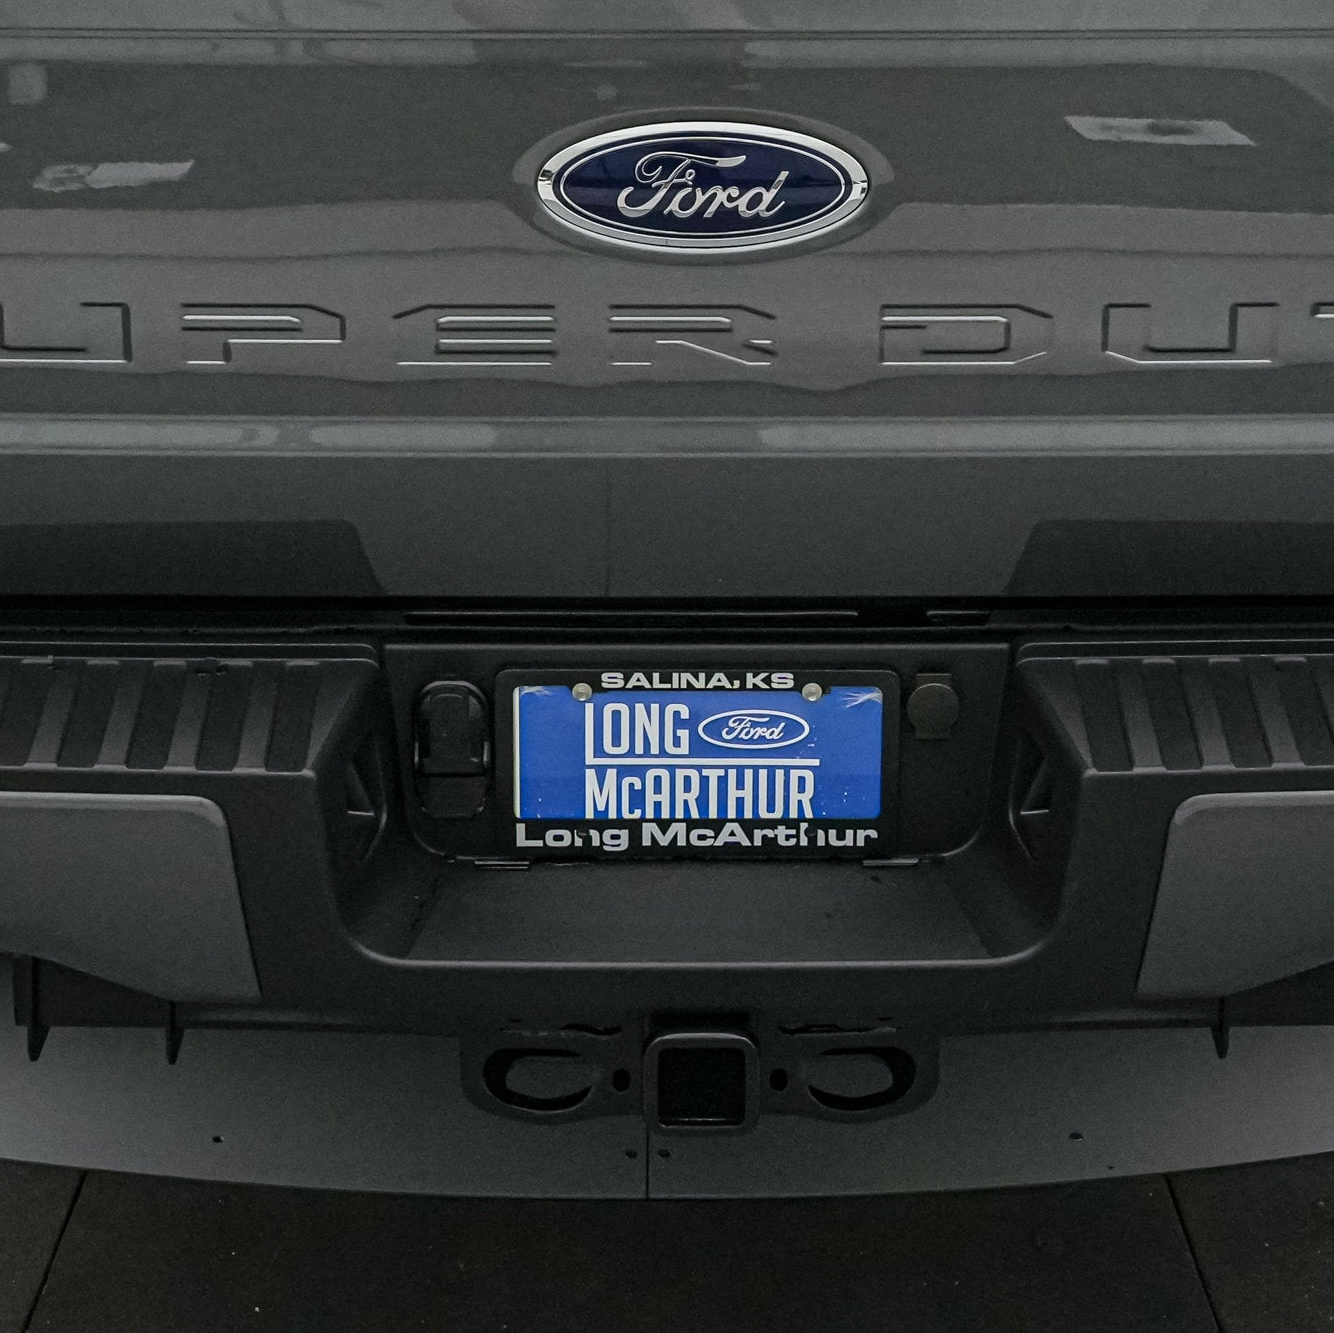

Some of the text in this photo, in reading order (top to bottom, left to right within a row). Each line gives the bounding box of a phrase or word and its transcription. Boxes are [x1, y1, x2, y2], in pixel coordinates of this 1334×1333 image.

[617, 151, 790, 217] Ford
[600, 672, 795, 690] SALINA, KS
[584, 702, 690, 765] LONG
[721, 716, 785, 742] Ford
[584, 768, 815, 819] McARTHUR
[515, 822, 879, 851] Long McArthur
